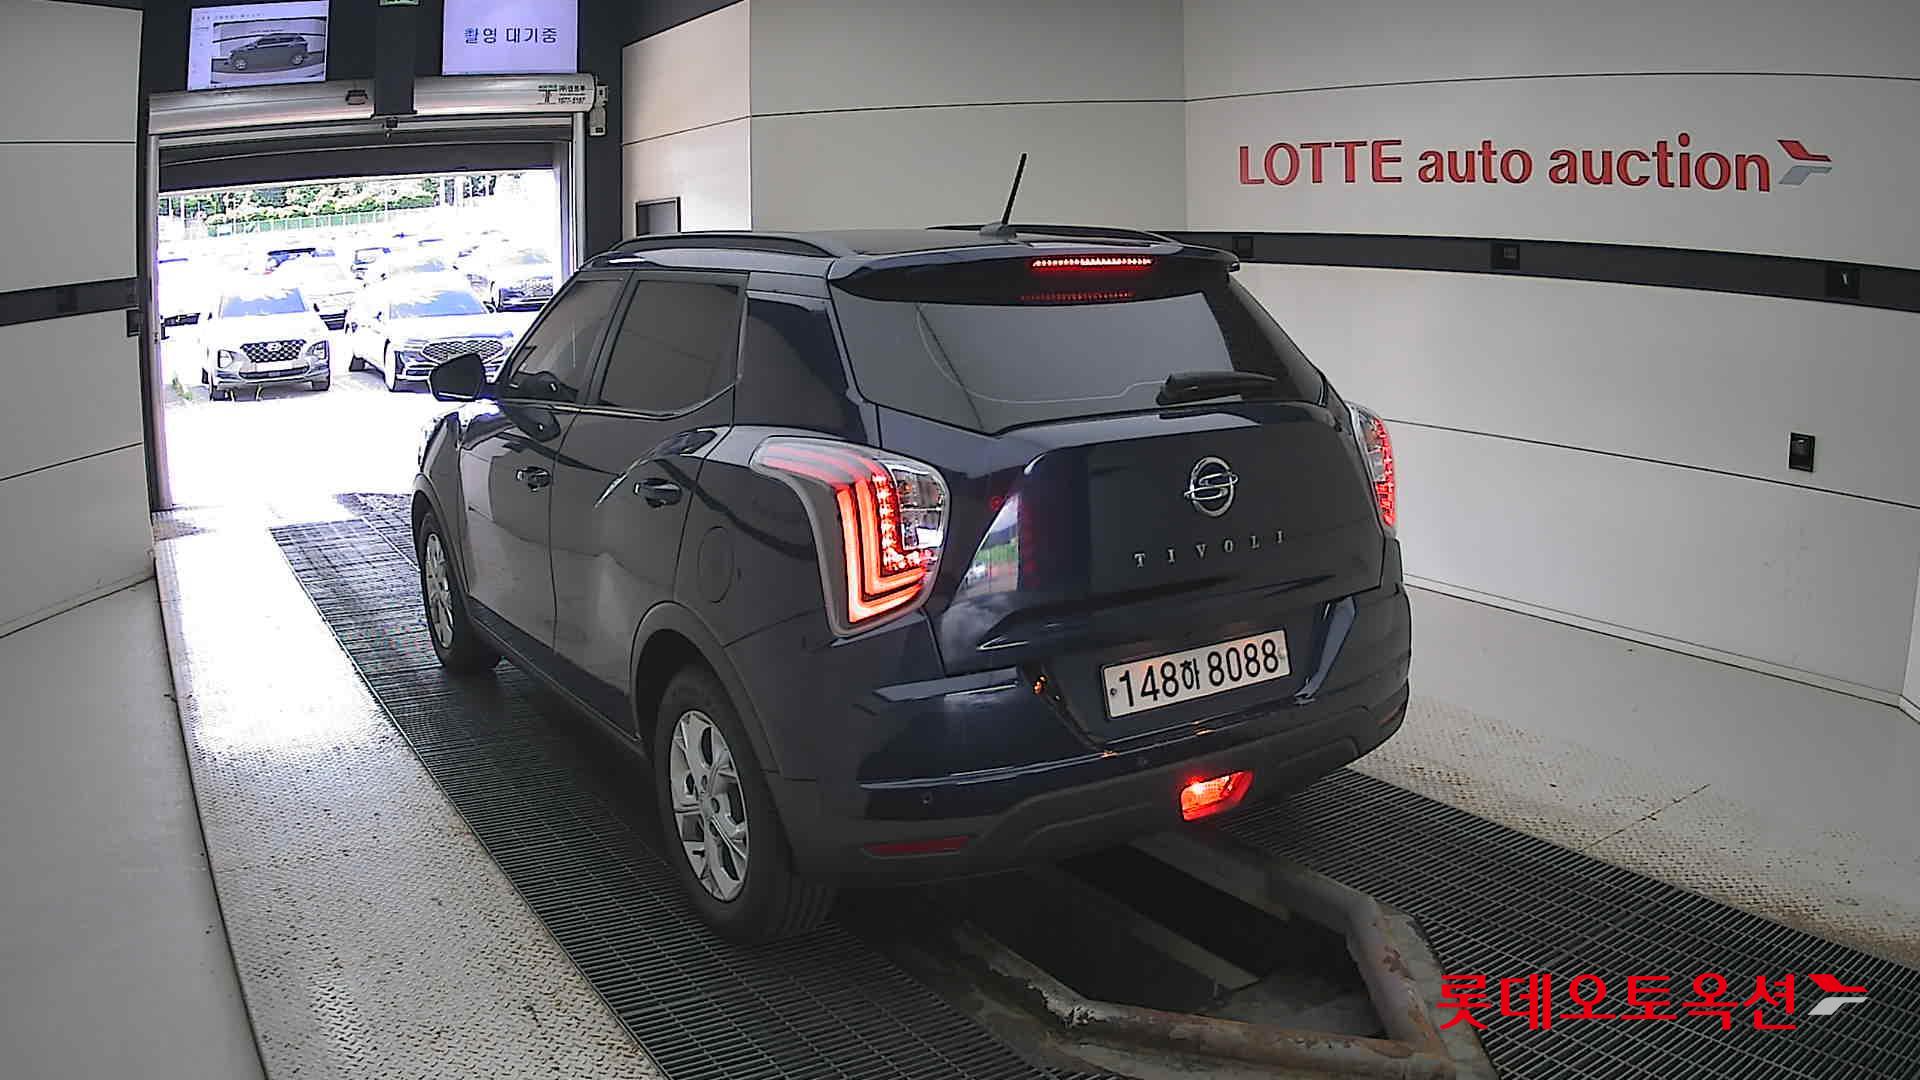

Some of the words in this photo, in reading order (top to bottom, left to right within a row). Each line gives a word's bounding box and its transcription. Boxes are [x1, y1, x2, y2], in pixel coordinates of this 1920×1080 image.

[505, 27, 558, 43] 대기중
[1239, 138, 1403, 186] LOTTE
[1417, 139, 1534, 184] auto
[1547, 132, 1771, 193] auction
[1133, 530, 1285, 569] TIVOLI
[1118, 658, 1200, 707] 148하
[1207, 638, 1280, 687] 8088
